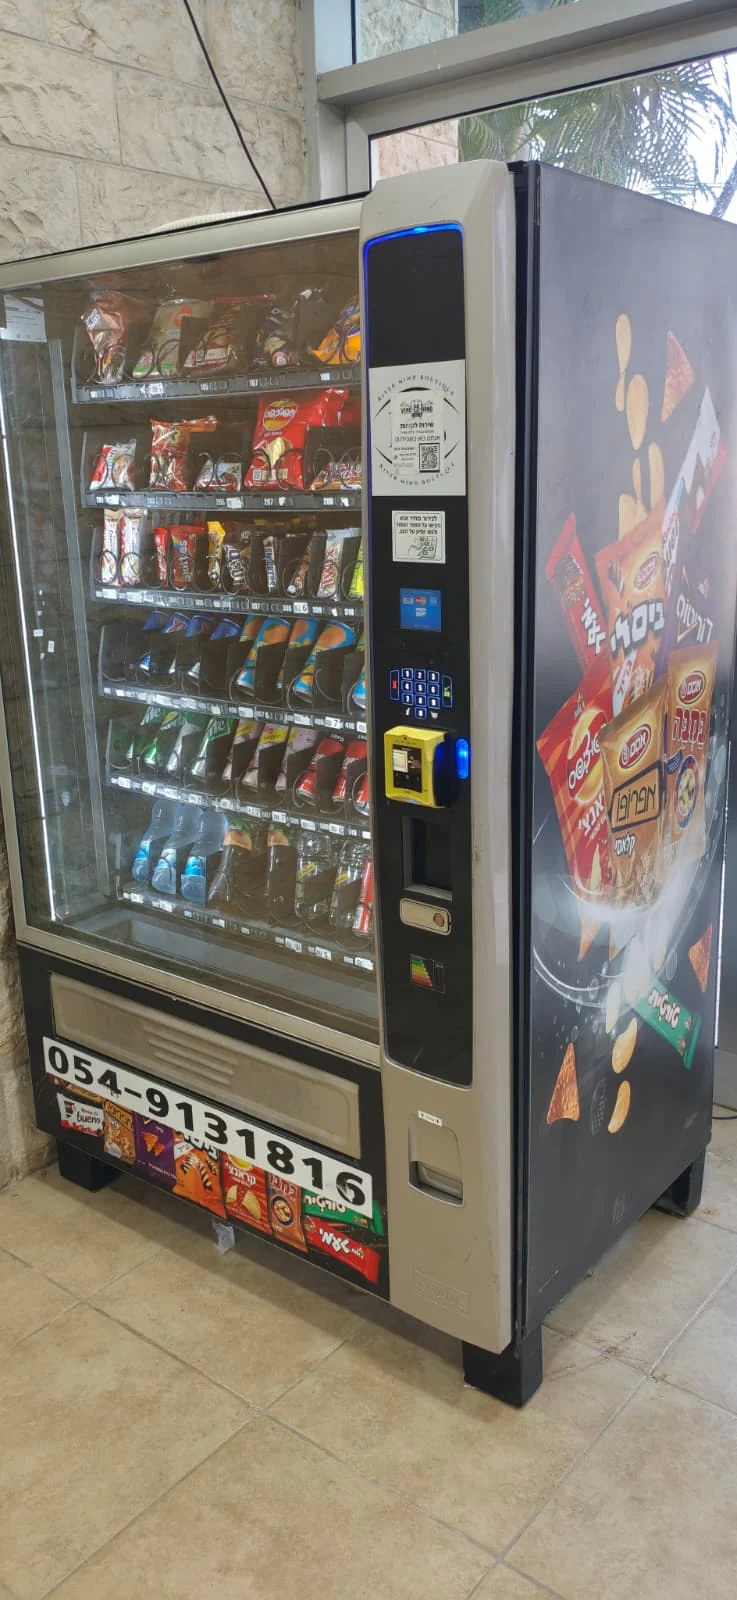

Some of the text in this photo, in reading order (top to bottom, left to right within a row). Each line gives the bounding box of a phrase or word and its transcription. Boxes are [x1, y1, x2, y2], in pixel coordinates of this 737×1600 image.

[610, 602, 665, 653] ביסלי
[616, 783, 657, 823] אפרופו
[47, 1045, 366, 1207] 054-9131816
